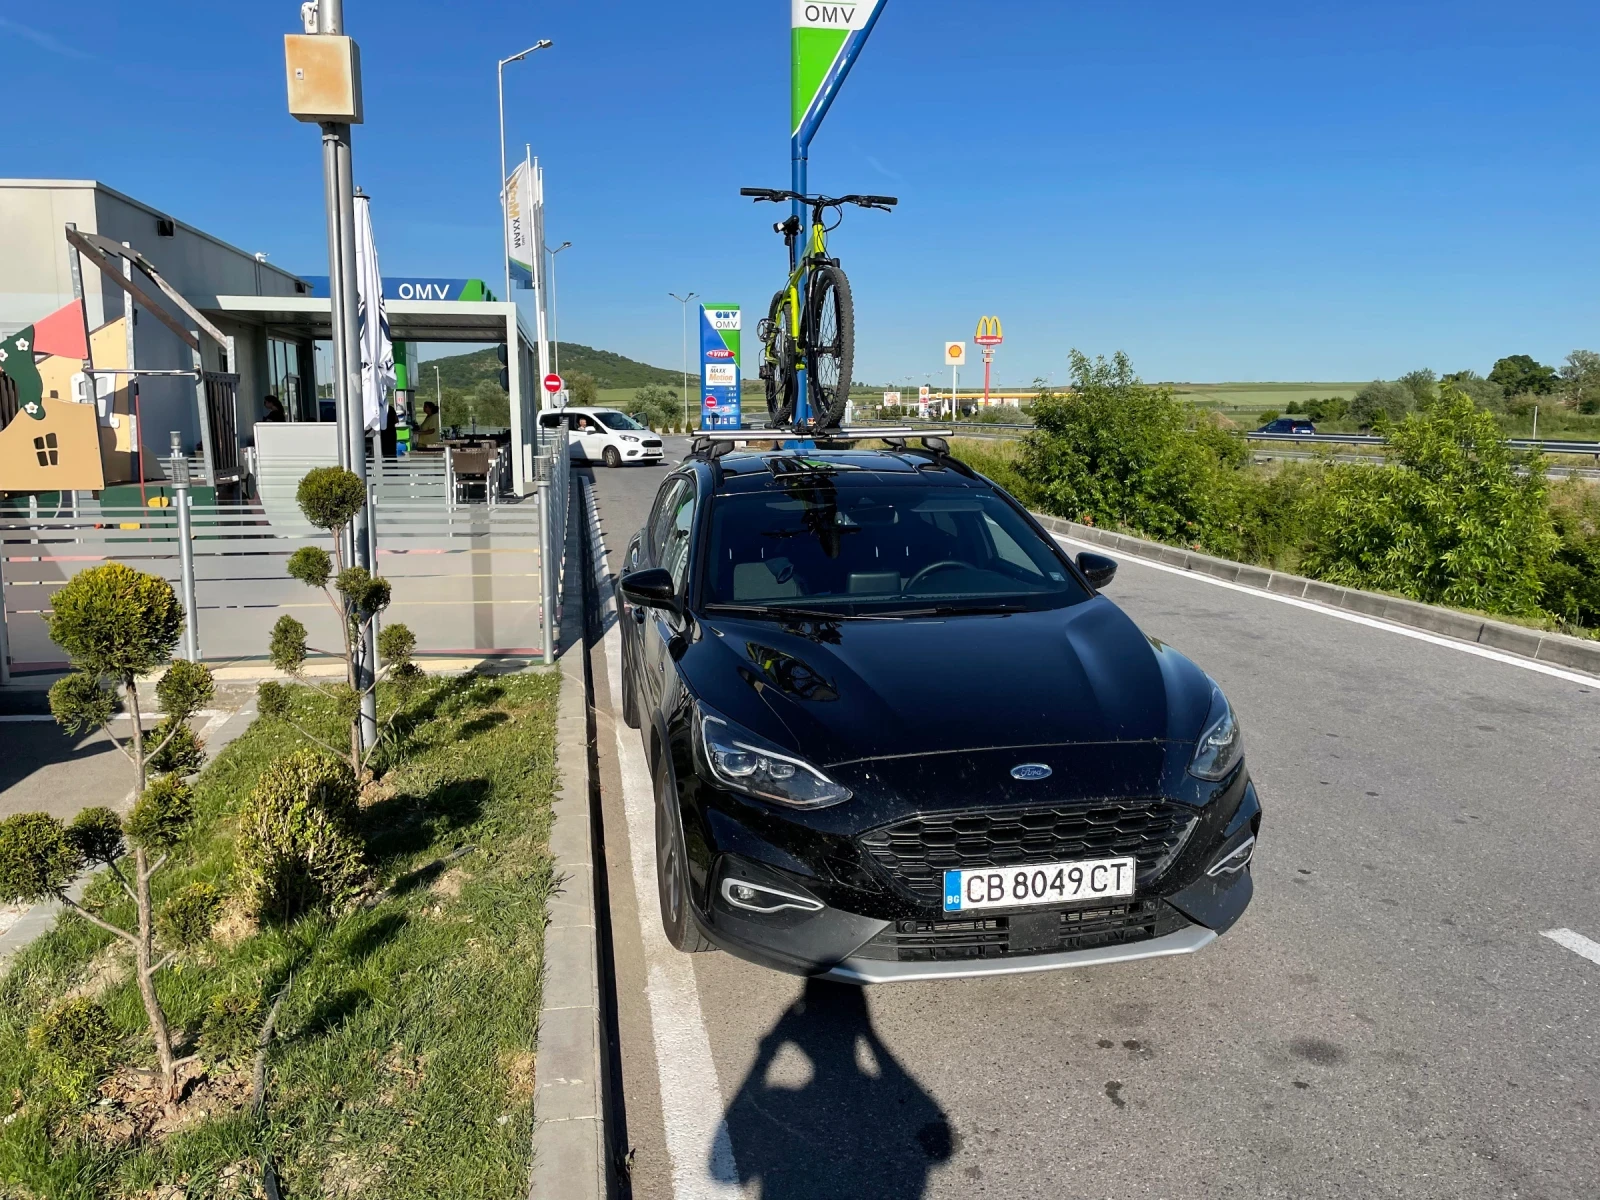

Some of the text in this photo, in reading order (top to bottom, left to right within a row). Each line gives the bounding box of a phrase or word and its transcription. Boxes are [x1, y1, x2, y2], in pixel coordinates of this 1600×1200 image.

[805, 5, 855, 23] OMV
[398, 284, 450, 300] OMV
[715, 320, 737, 328] OMV
[708, 373, 733, 381] Motion
[1020, 767, 1043, 777] Ford
[967, 862, 1128, 903] CB 8049 CT
[946, 895, 960, 904] BG
